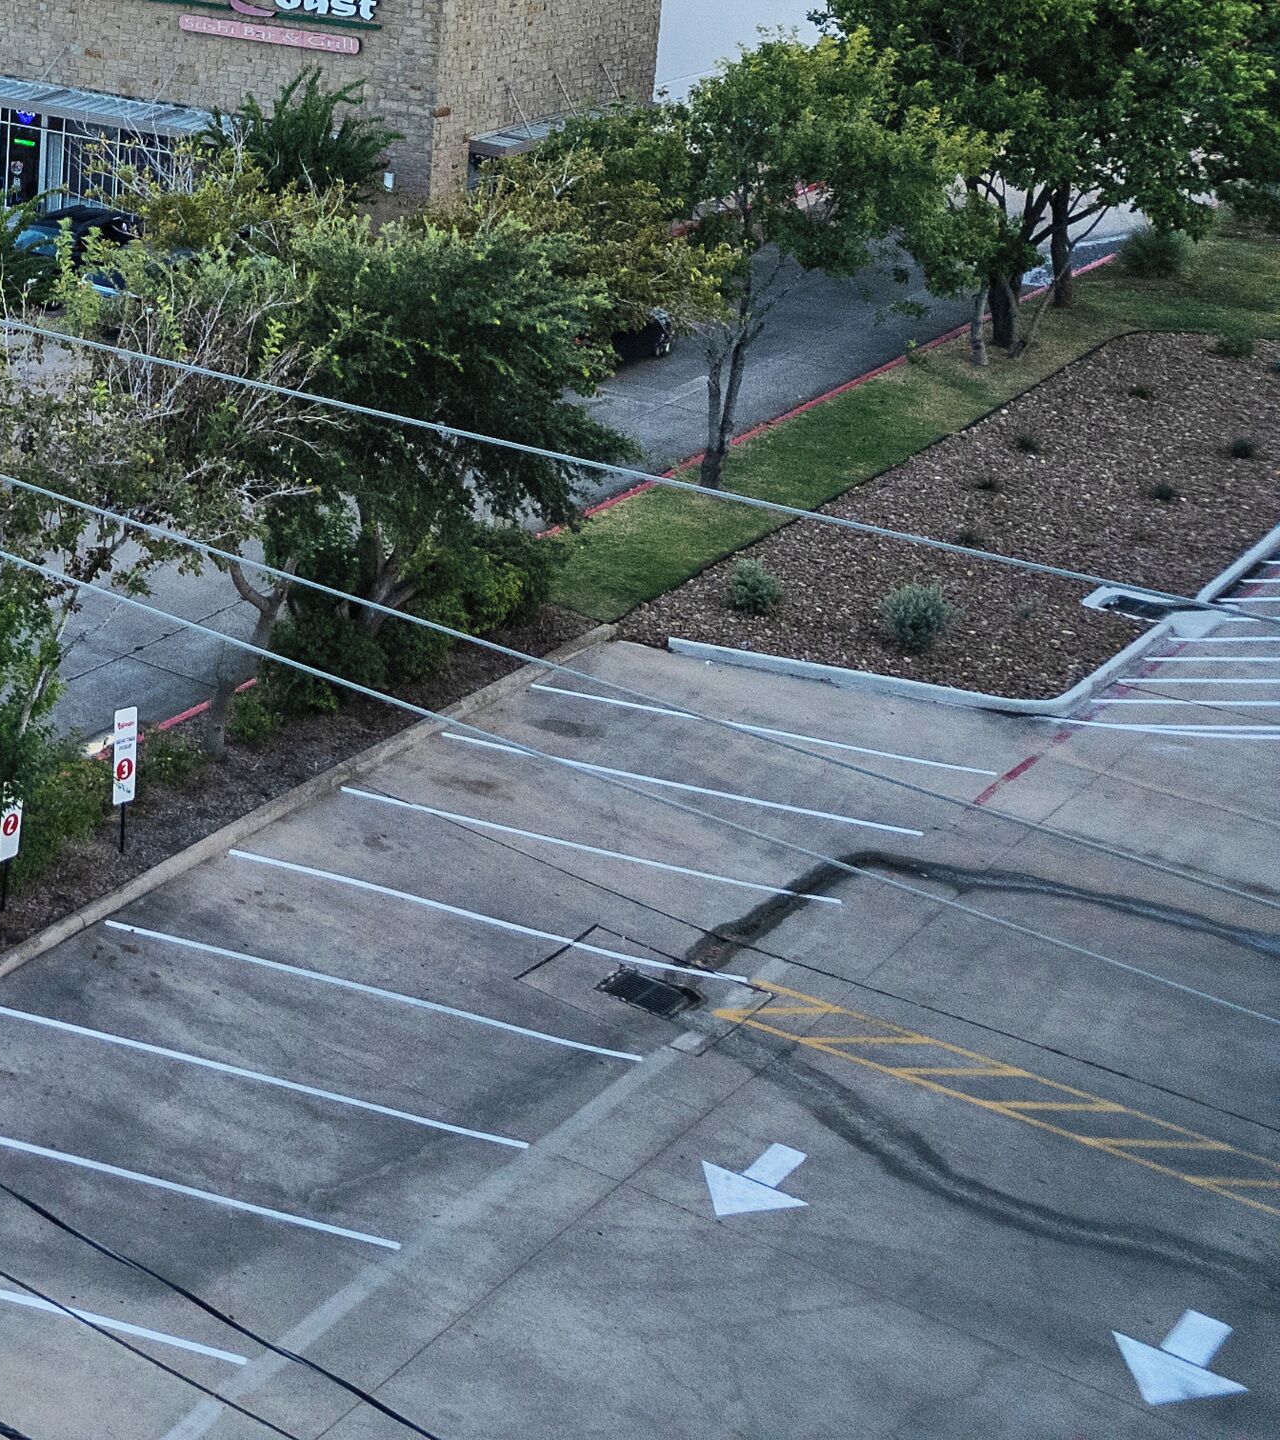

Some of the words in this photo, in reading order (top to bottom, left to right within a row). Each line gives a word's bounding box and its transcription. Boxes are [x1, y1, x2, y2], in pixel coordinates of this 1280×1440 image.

[184, 16, 235, 35] Sushi
[243, 22, 274, 40] Bar
[282, 31, 299, 42] &
[308, 34, 354, 51] Grill
[121, 760, 129, 776] 3
[7, 814, 16, 834] 2
